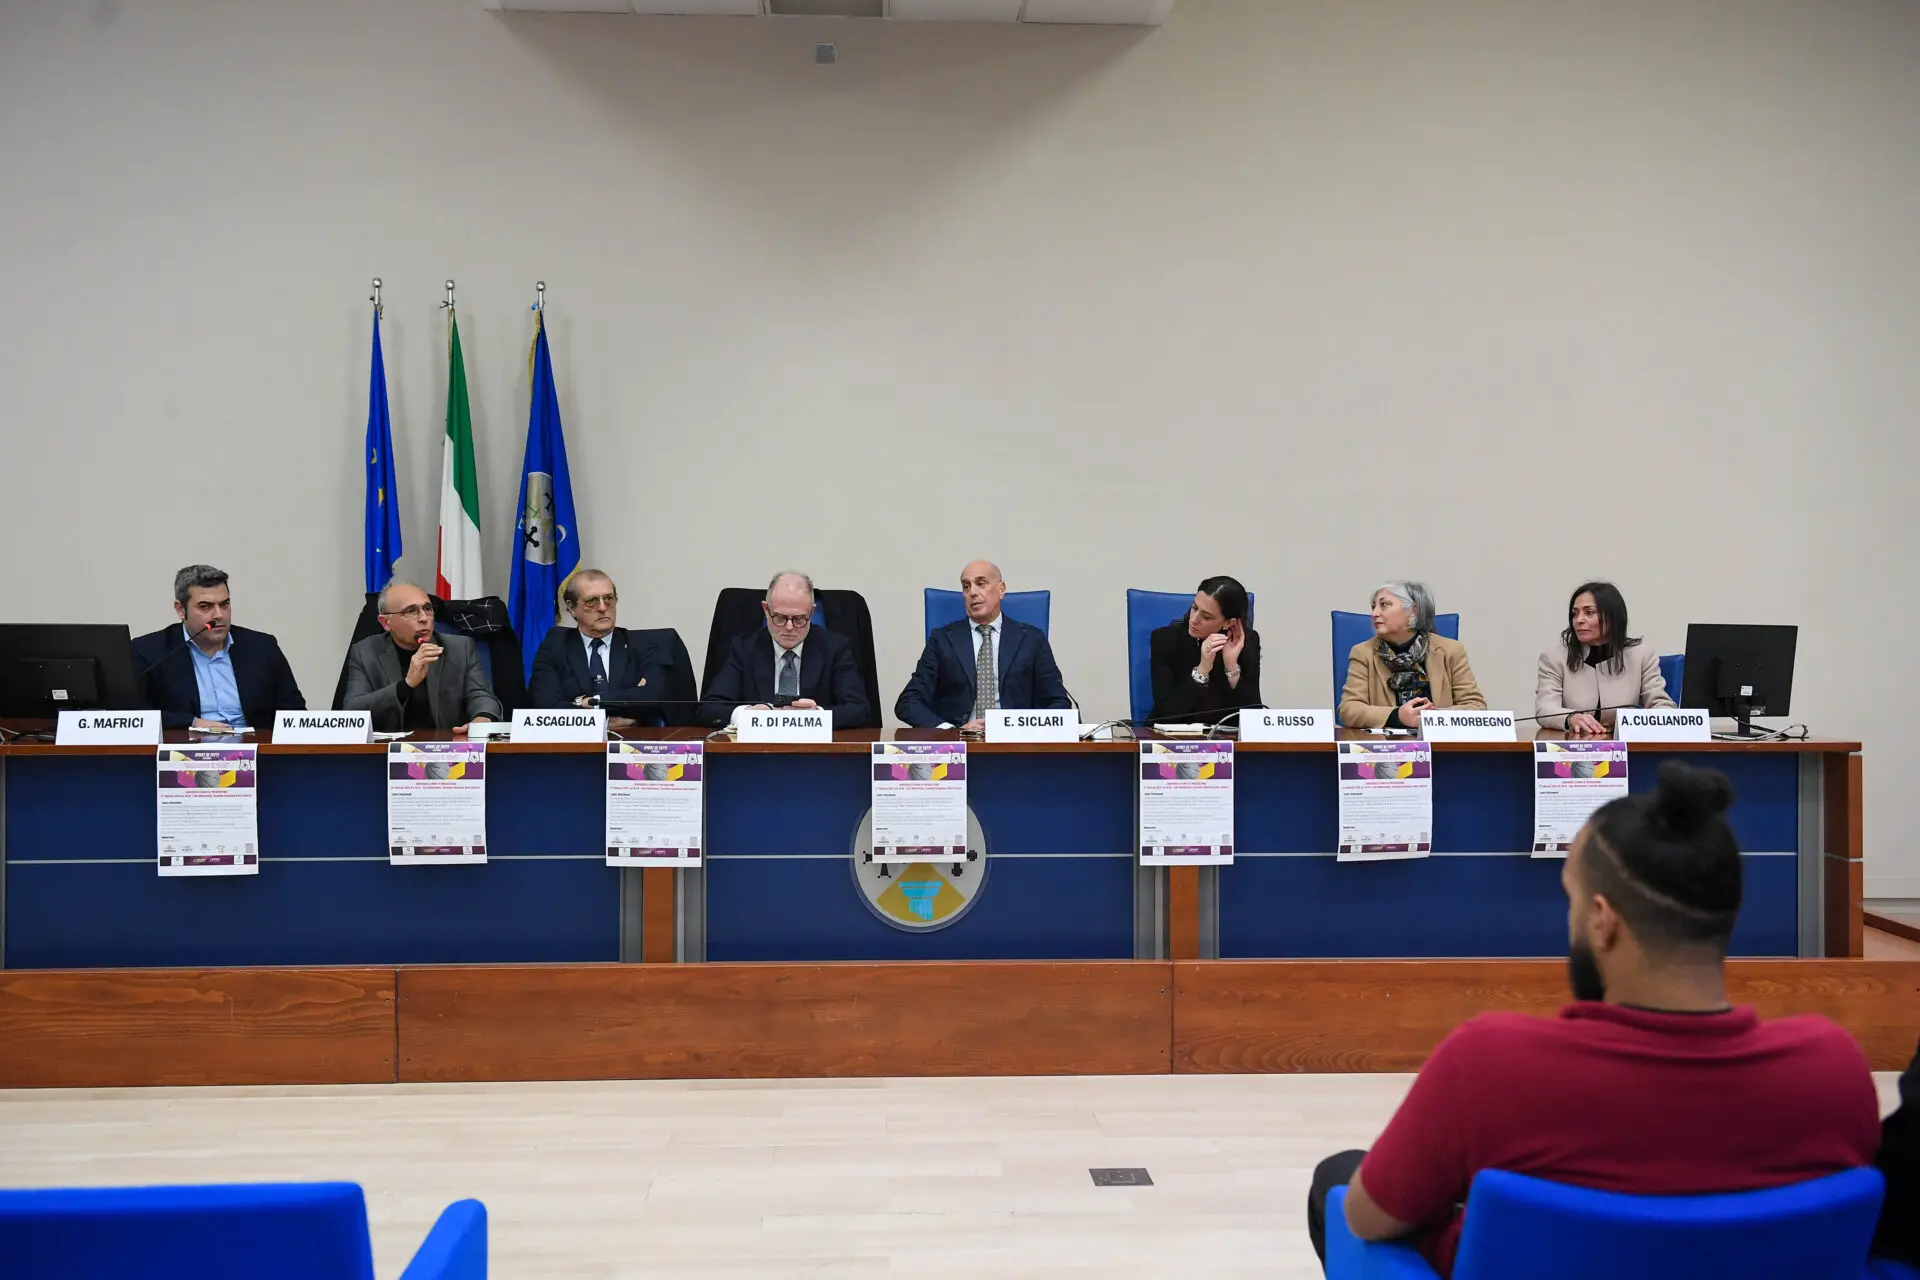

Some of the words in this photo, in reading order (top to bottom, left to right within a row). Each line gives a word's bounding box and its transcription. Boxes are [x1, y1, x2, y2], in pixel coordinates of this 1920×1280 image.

[78, 718, 90, 729] G.
[93, 717, 144, 729] MAFRICI
[282, 717, 296, 729] W.
[298, 717, 365, 729] MALACRINO
[536, 715, 596, 727] SCAGLIOLA
[751, 716, 763, 728] R.
[766, 716, 779, 728] DI
[782, 716, 823, 728] PALMA
[1003, 716, 1015, 727] E.
[1017, 716, 1064, 727] SICLARI
[1263, 715, 1275, 727] G.
[1277, 715, 1315, 727] RUSSO
[1450, 716, 1512, 727] MORBEGNO
